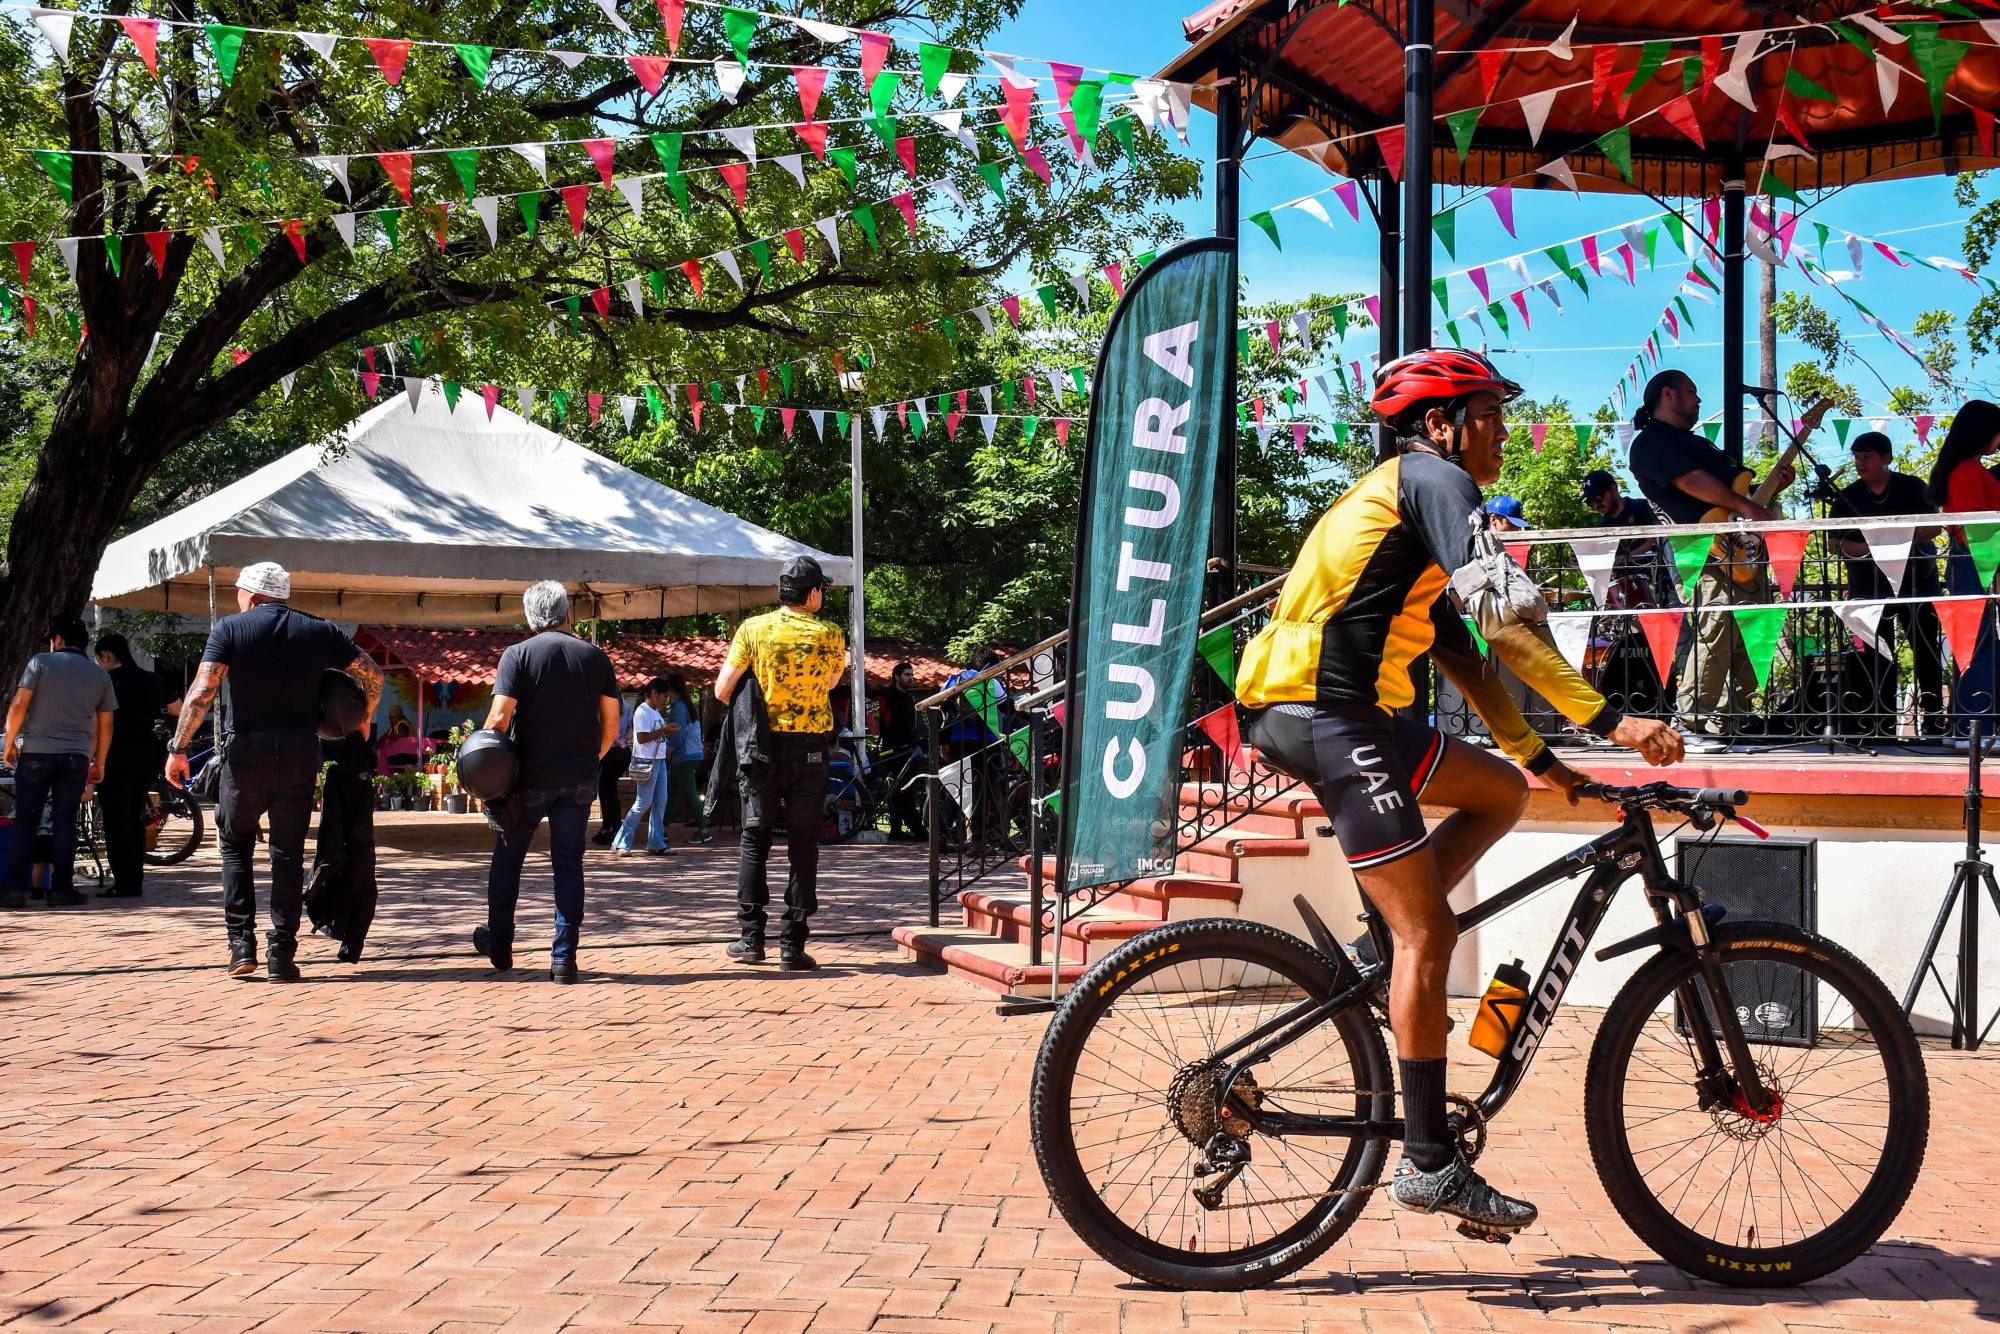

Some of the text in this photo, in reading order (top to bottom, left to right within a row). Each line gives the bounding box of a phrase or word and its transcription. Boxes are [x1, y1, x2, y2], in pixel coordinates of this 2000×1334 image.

[1103, 320, 1199, 800] CULTURA
[1351, 744, 1405, 814] UAE
[1137, 858, 1173, 871] IMCC
[1099, 943, 1180, 997] MAXXIS
[1511, 917, 1585, 1061] SCOTT
[1706, 1254, 1792, 1272] MAXXIS
